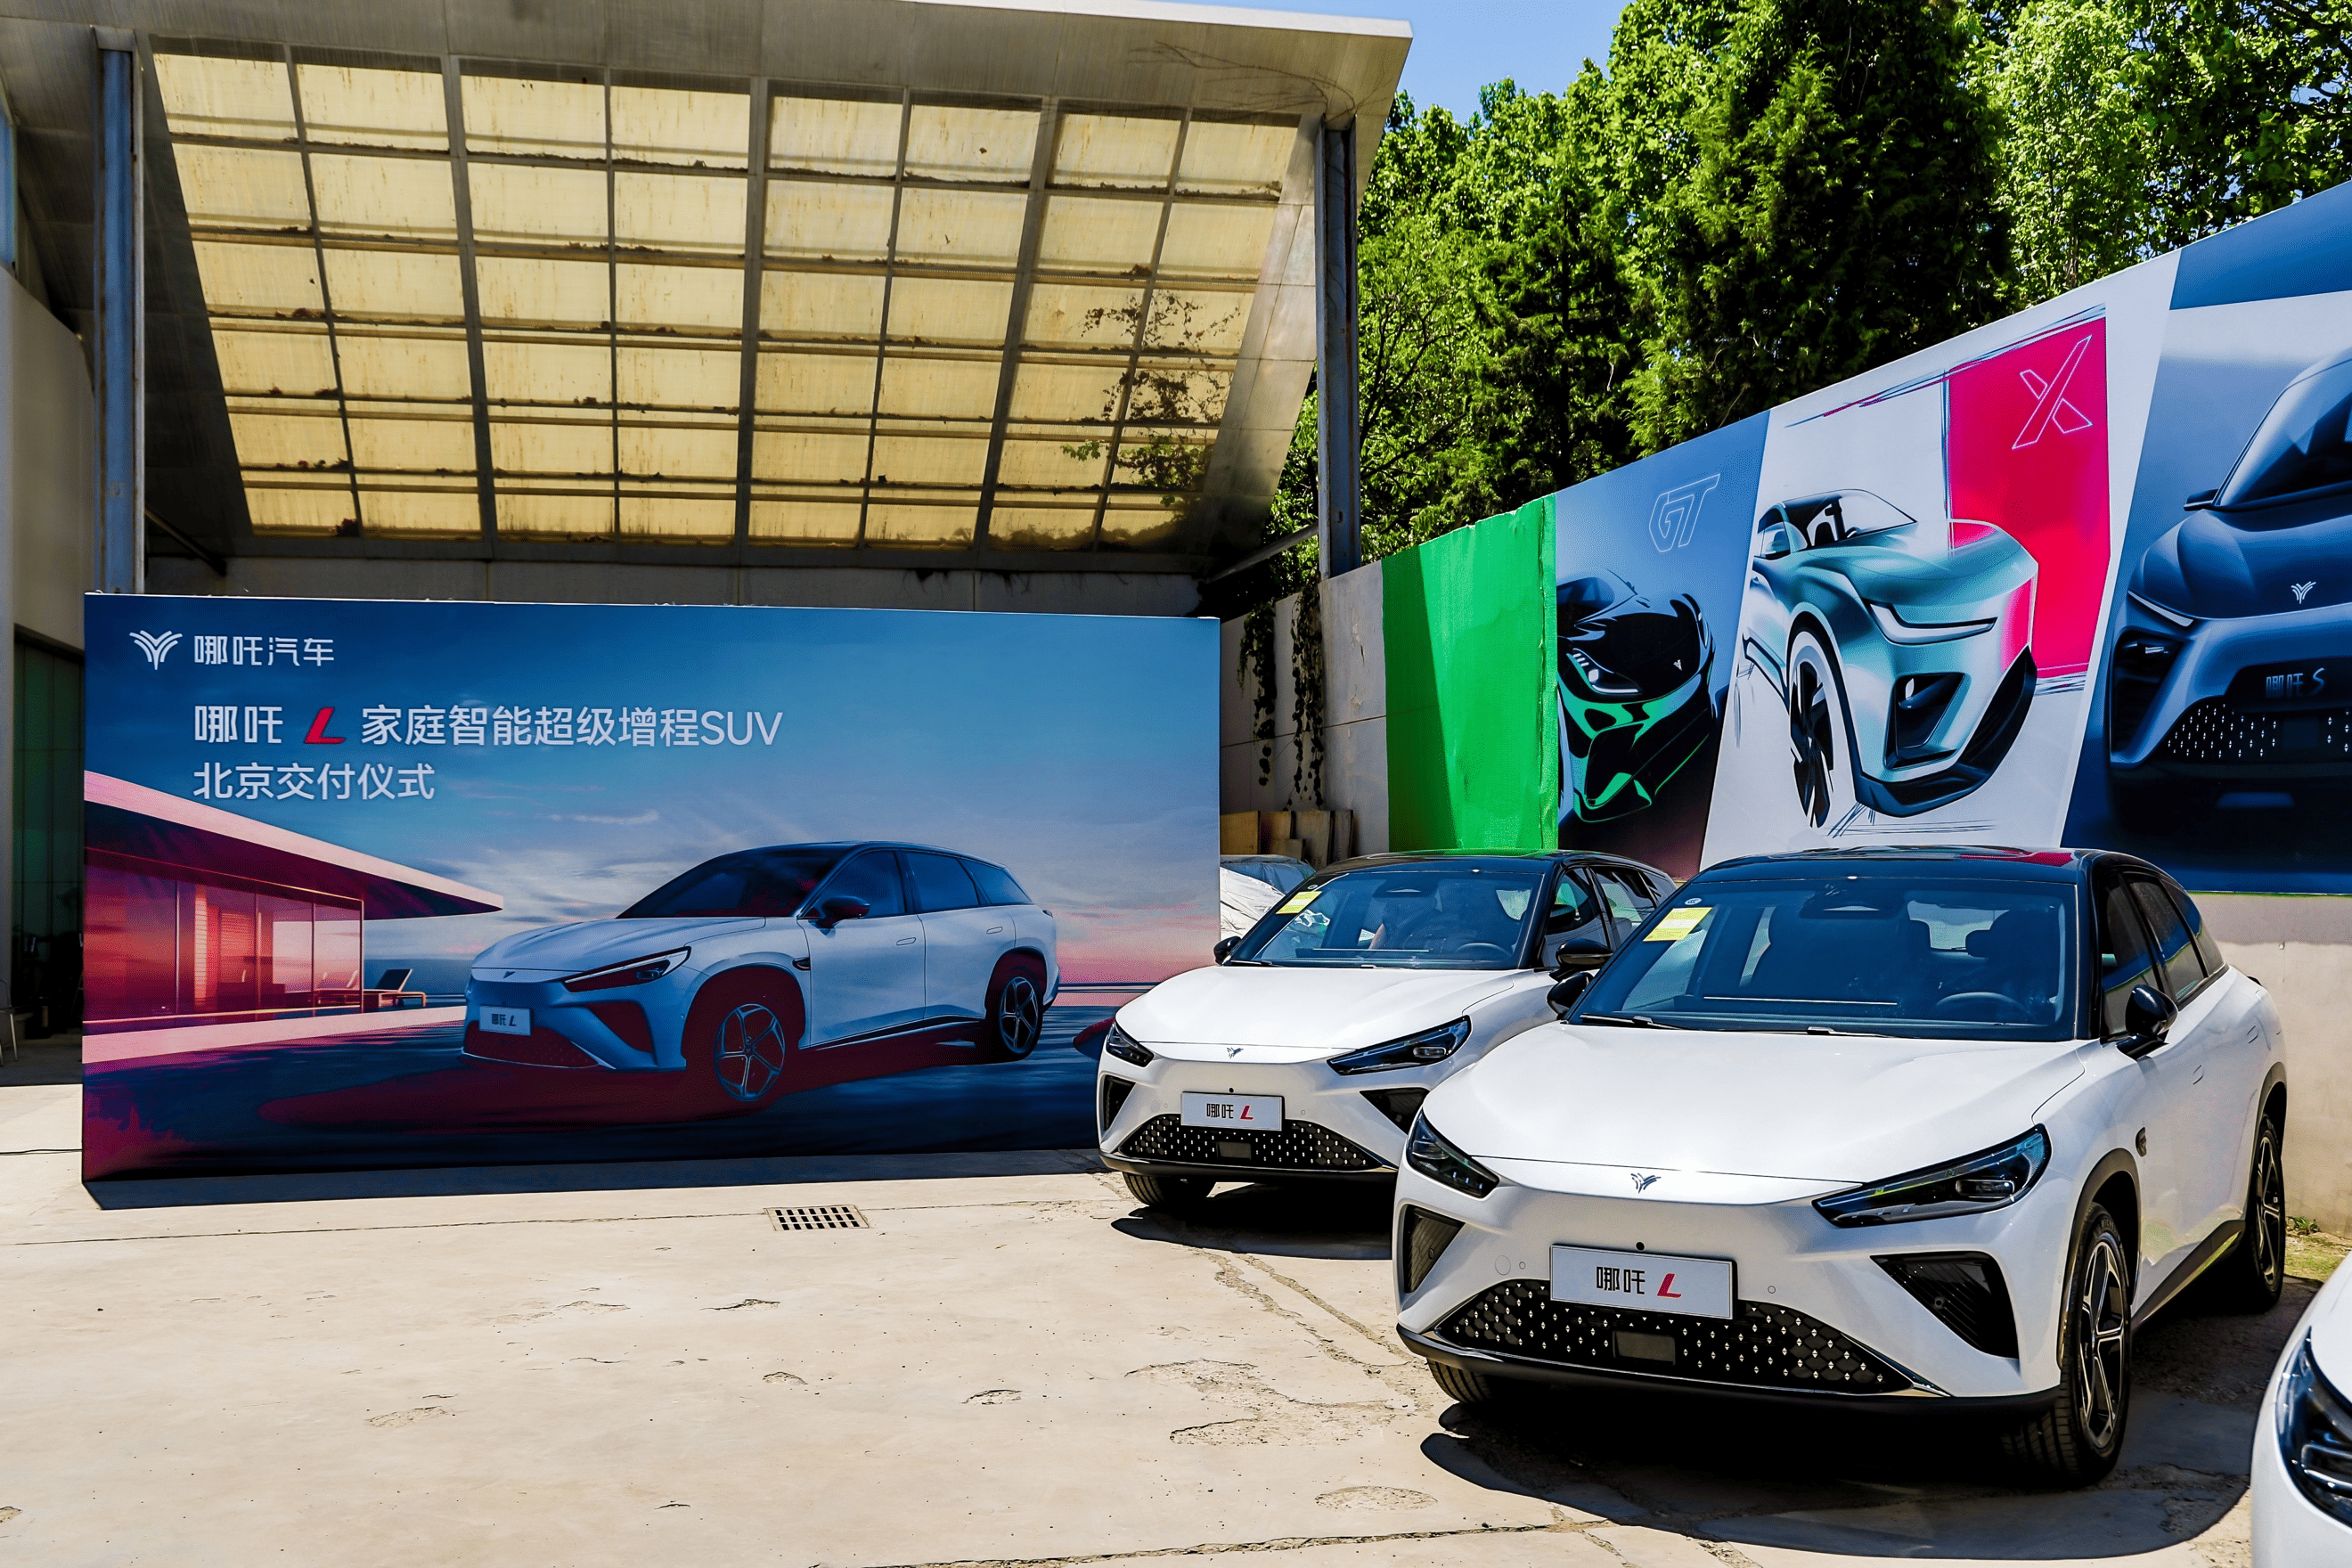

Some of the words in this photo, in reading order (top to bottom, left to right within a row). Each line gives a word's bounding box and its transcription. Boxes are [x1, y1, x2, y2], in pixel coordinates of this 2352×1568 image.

[2012, 334, 2093, 450] X
[1648, 473, 1721, 552] GT
[193, 635, 335, 666] 哪吒汽车
[194, 706, 283, 744] 哪吒
[303, 706, 346, 744] L
[361, 704, 784, 747] 家庭智能超级增程SUV
[192, 762, 436, 800] 北京交付仪式
[1206, 1103, 1234, 1119] 哪吒
[1239, 1105, 1254, 1120] L
[1596, 1266, 1646, 1295] 哪吒
[1656, 1272, 1682, 1299] L
